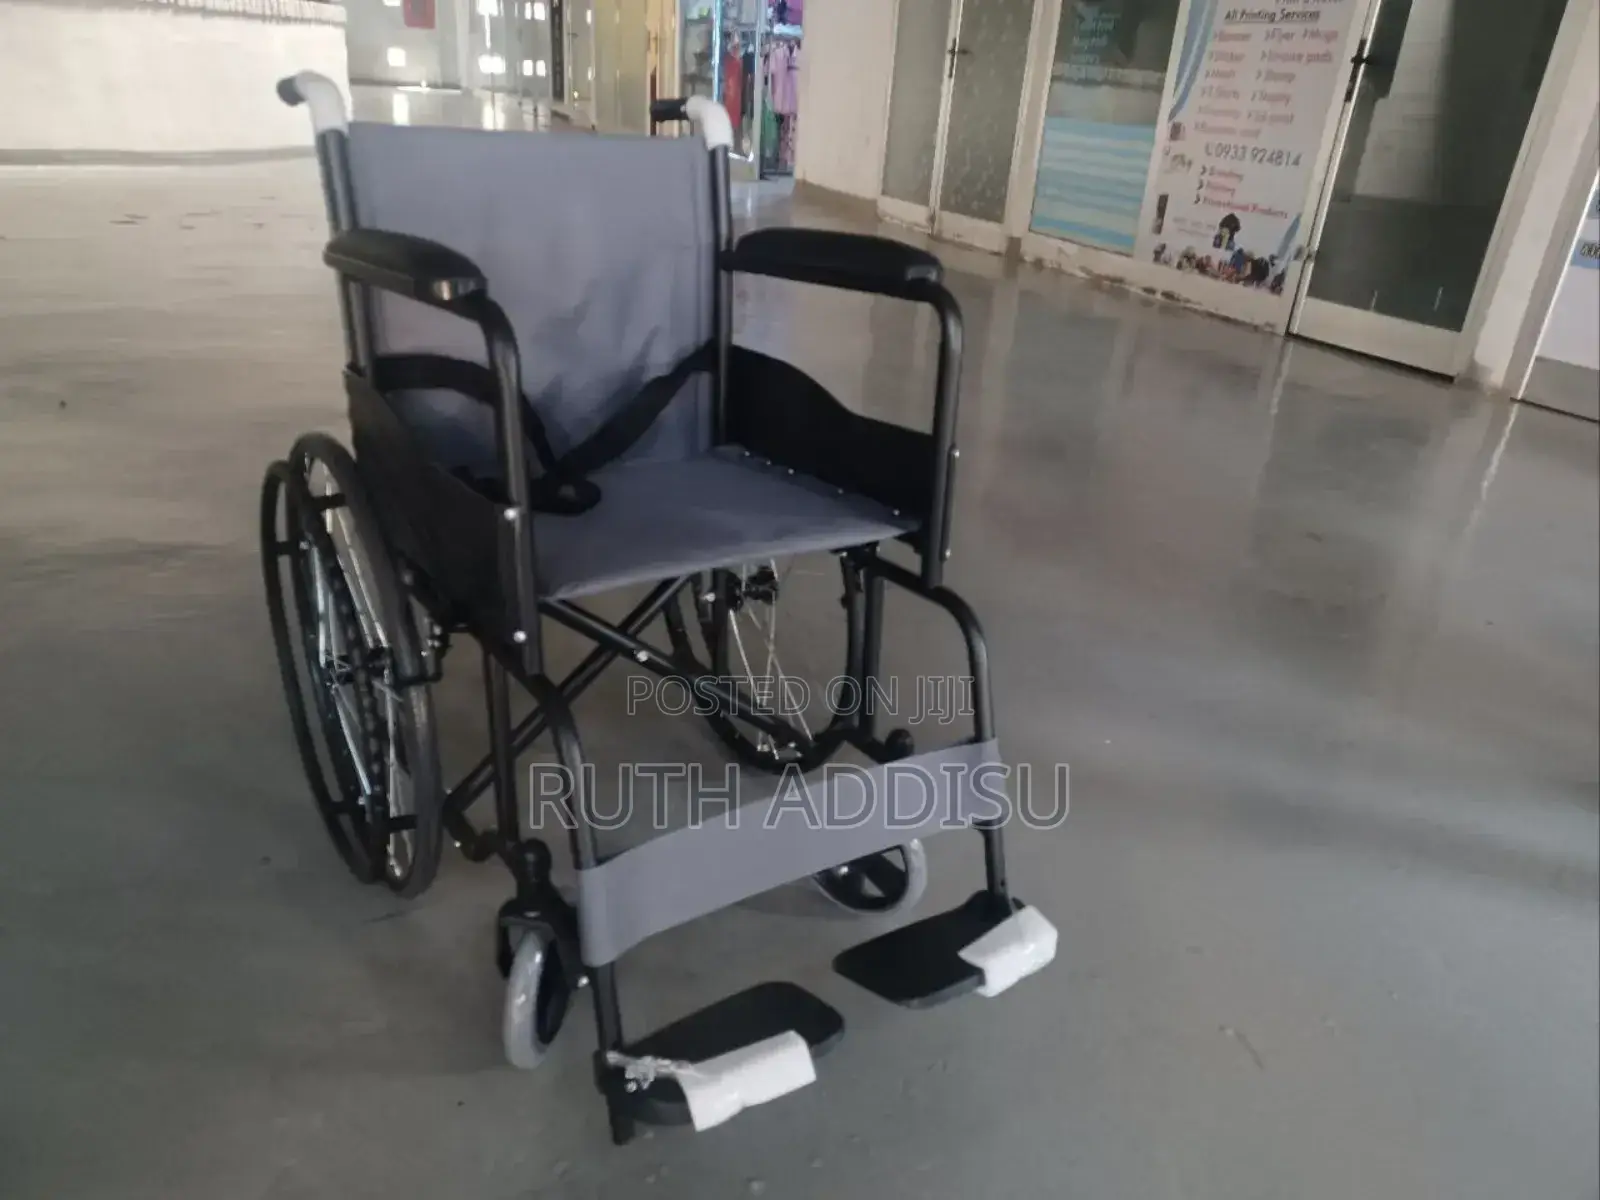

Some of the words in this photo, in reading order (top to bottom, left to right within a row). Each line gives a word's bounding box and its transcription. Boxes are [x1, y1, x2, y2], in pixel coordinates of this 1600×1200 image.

[1280, 8, 1321, 21] Services
[1215, 143, 1246, 161] 0933
[1251, 146, 1302, 166] 924814
